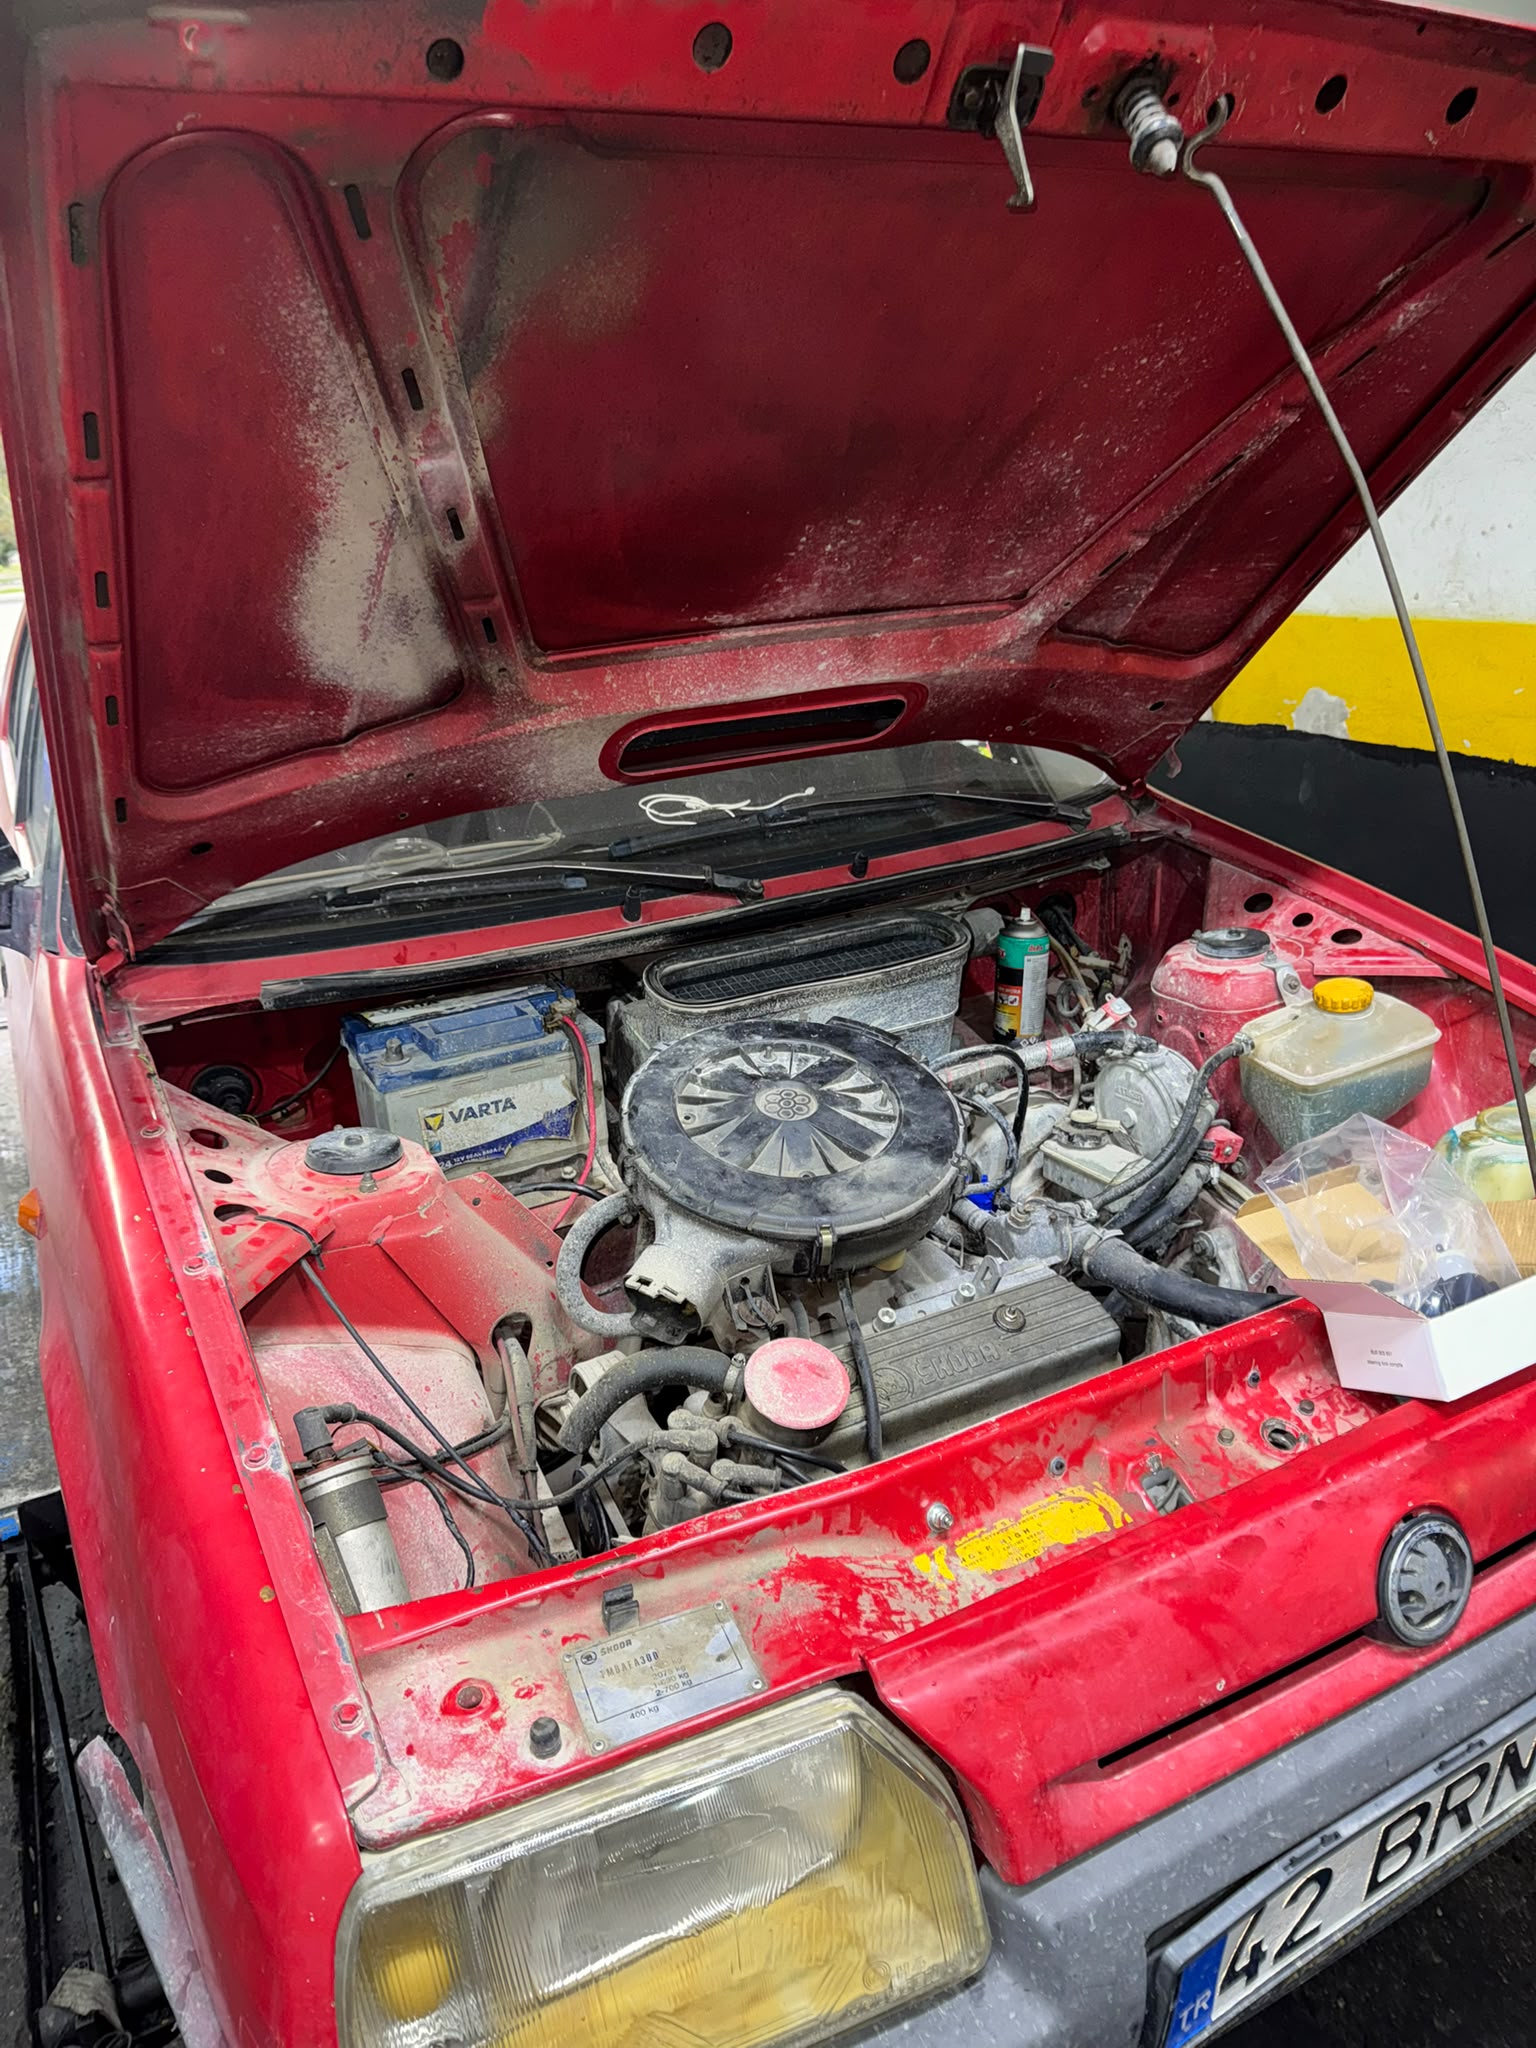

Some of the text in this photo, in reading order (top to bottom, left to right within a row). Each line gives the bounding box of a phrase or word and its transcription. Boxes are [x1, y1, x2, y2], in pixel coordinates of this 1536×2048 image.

[448, 1097, 517, 1124] VARTA
[678, 1671, 690, 1680] kg
[681, 1678, 693, 1687] kg
[630, 1704, 660, 1720] 400 kg
[1219, 1867, 1334, 1997] 42
[1179, 1989, 1211, 2033] TR
